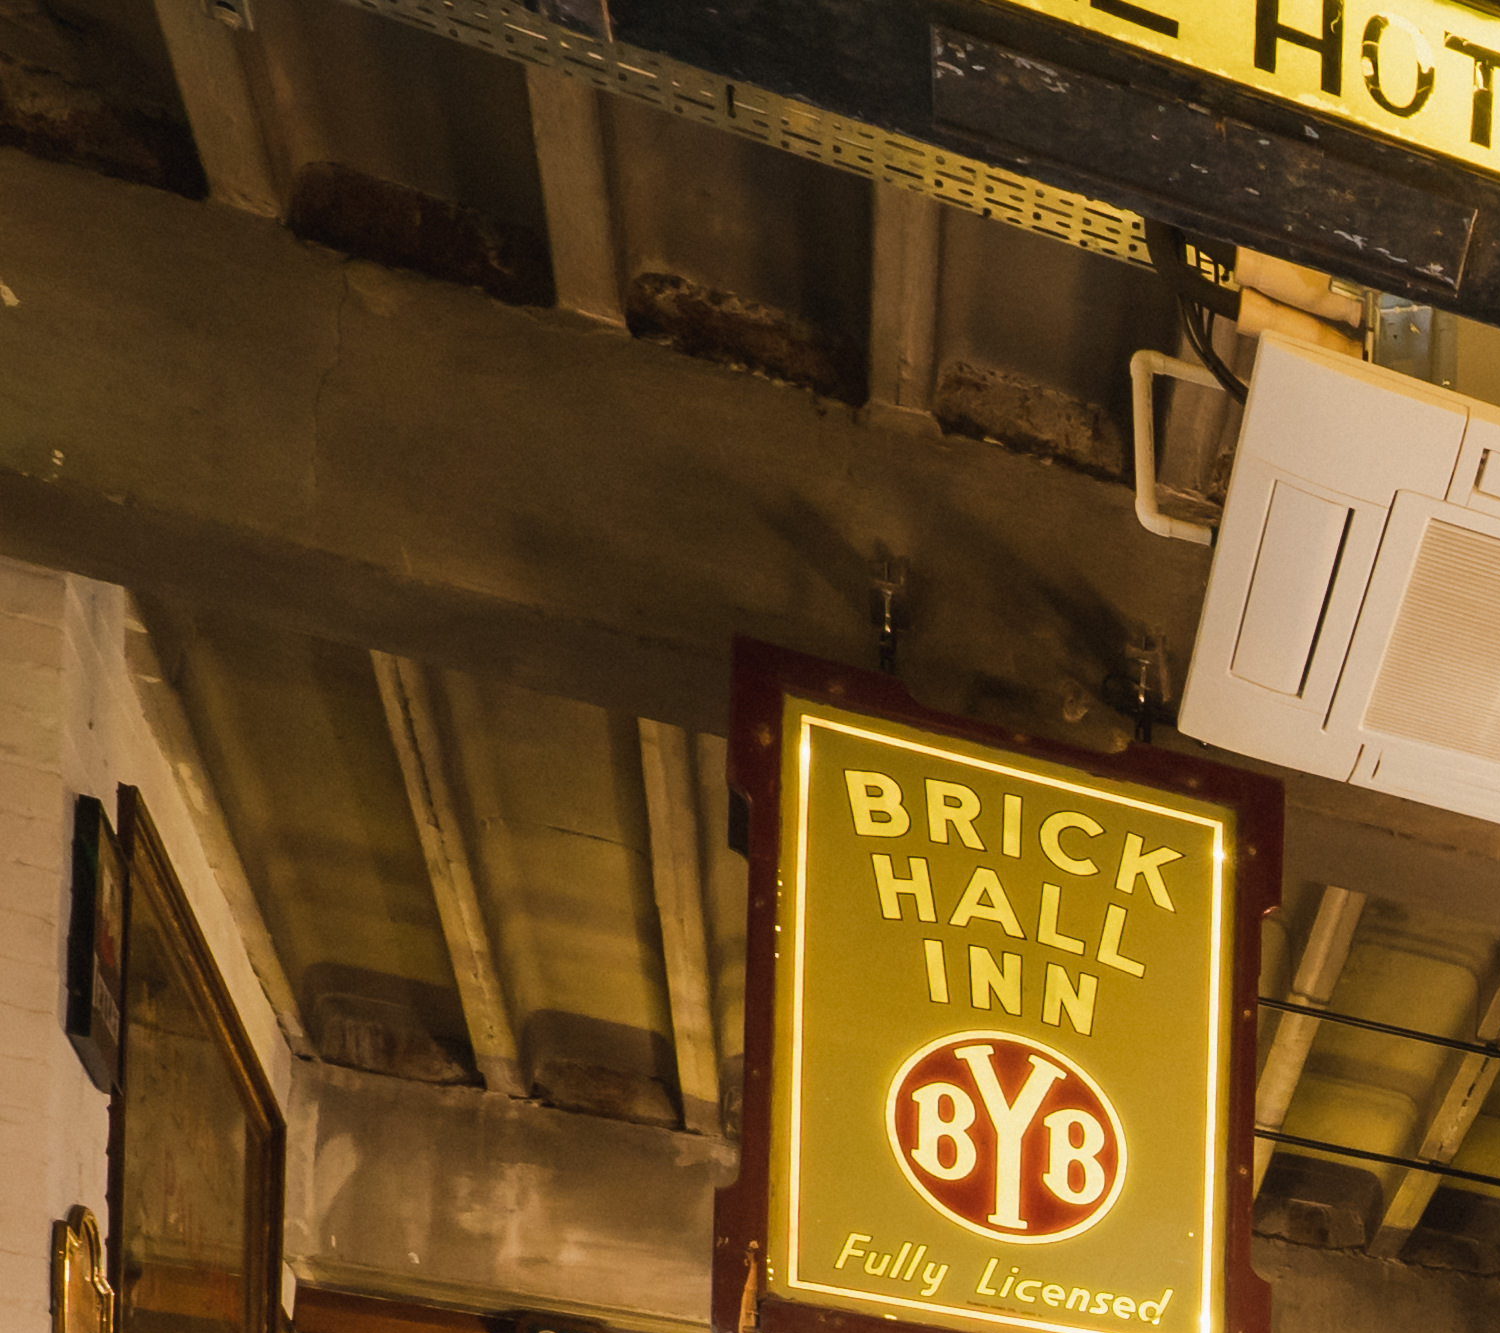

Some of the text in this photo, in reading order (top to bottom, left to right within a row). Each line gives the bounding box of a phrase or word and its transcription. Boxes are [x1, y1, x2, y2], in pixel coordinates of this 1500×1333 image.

[844, 768, 1186, 914] BRICK
[871, 853, 1148, 979] HALL
[922, 937, 1099, 1037] INN
[910, 1044, 1106, 1231] BYB
[834, 1233, 1174, 1325] Fully Licensed
